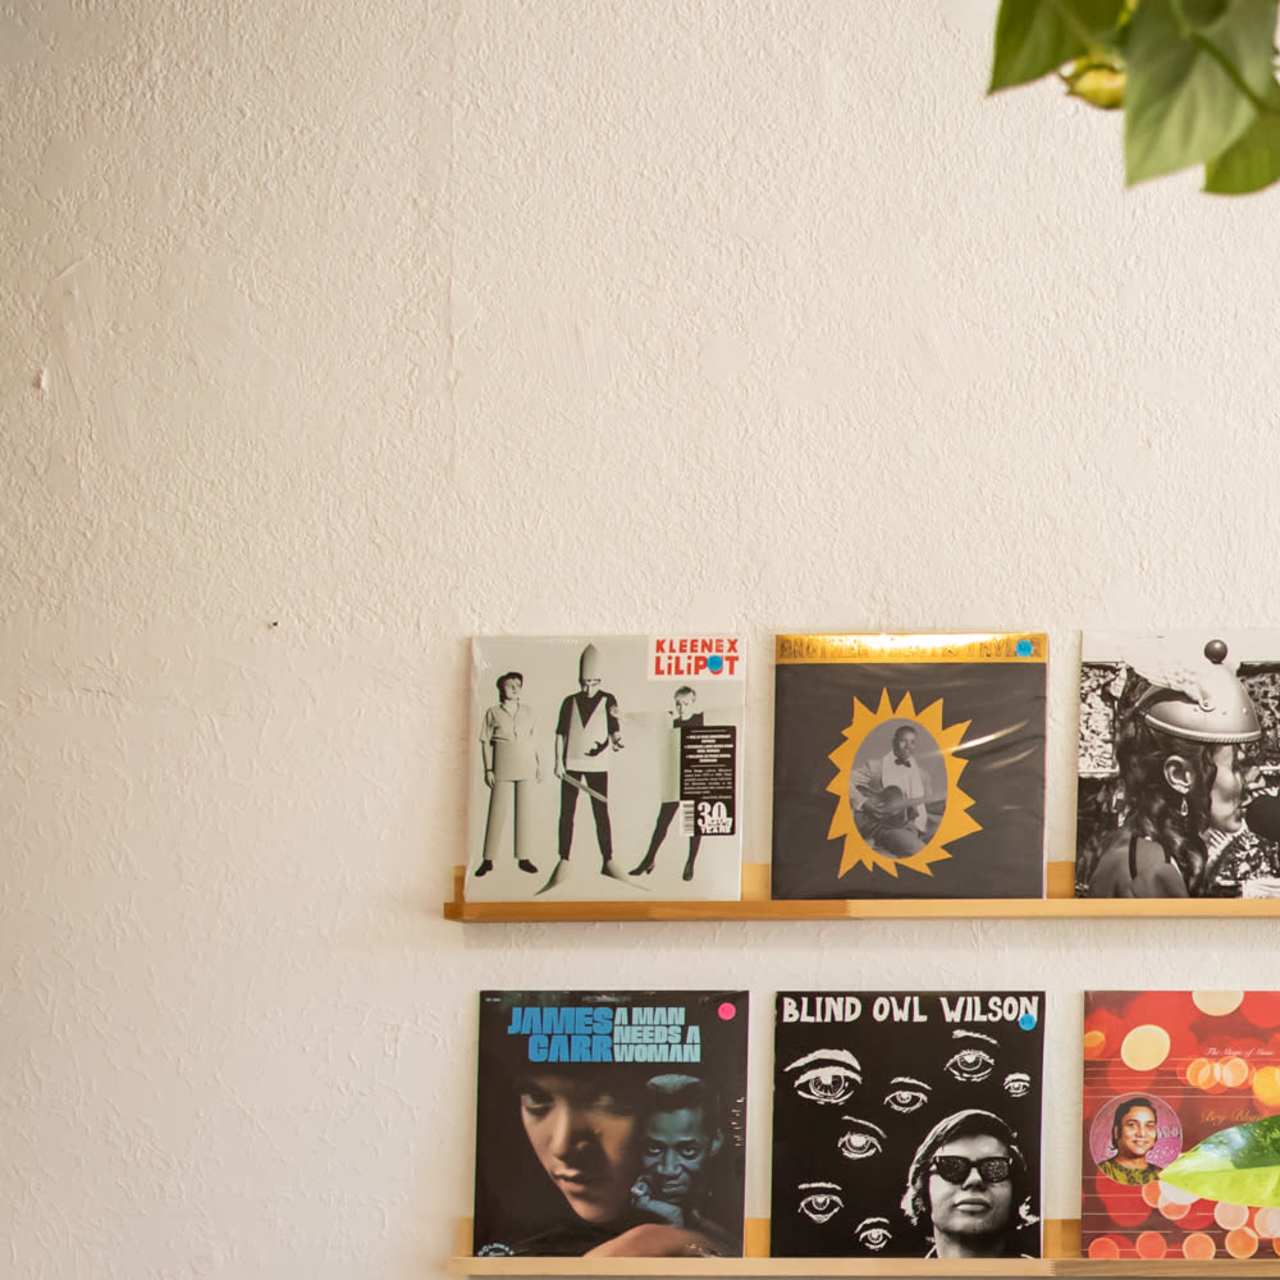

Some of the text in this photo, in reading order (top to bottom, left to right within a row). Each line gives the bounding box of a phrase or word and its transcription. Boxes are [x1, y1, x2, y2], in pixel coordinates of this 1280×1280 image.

[656, 638, 738, 653] KLEENEX
[655, 655, 740, 675] LiLiPT
[614, 1007, 686, 1024] A MAN
[782, 995, 1039, 1023] BLIND OWL WILSON
[507, 1006, 613, 1034] JAMES
[614, 1026, 700, 1043] NEEDS A
[528, 1034, 613, 1062] CARR
[614, 1044, 701, 1062] WOMAN
